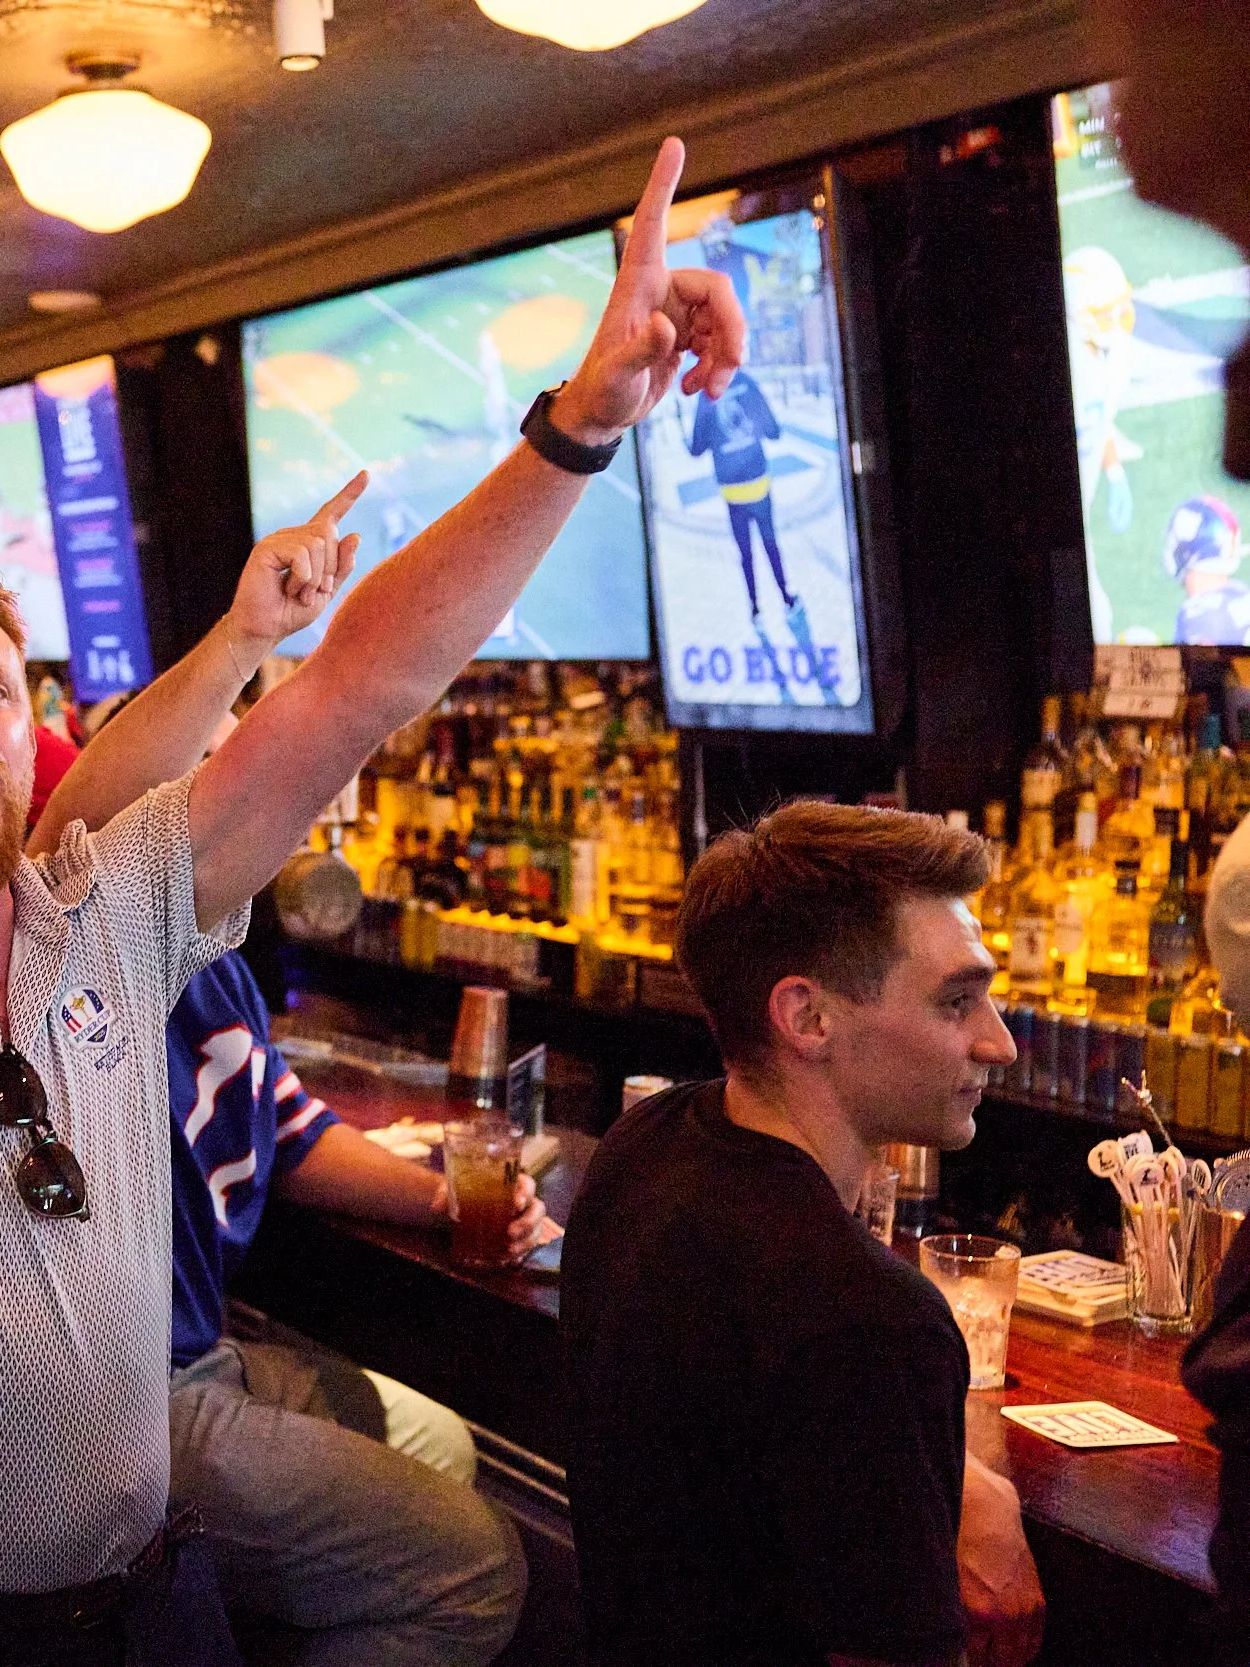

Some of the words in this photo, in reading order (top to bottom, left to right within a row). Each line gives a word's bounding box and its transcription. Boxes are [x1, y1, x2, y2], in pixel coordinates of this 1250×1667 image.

[683, 645, 732, 685] GO
[73, 1021, 101, 1044] RYDER
[97, 1009, 112, 1025] CUP
